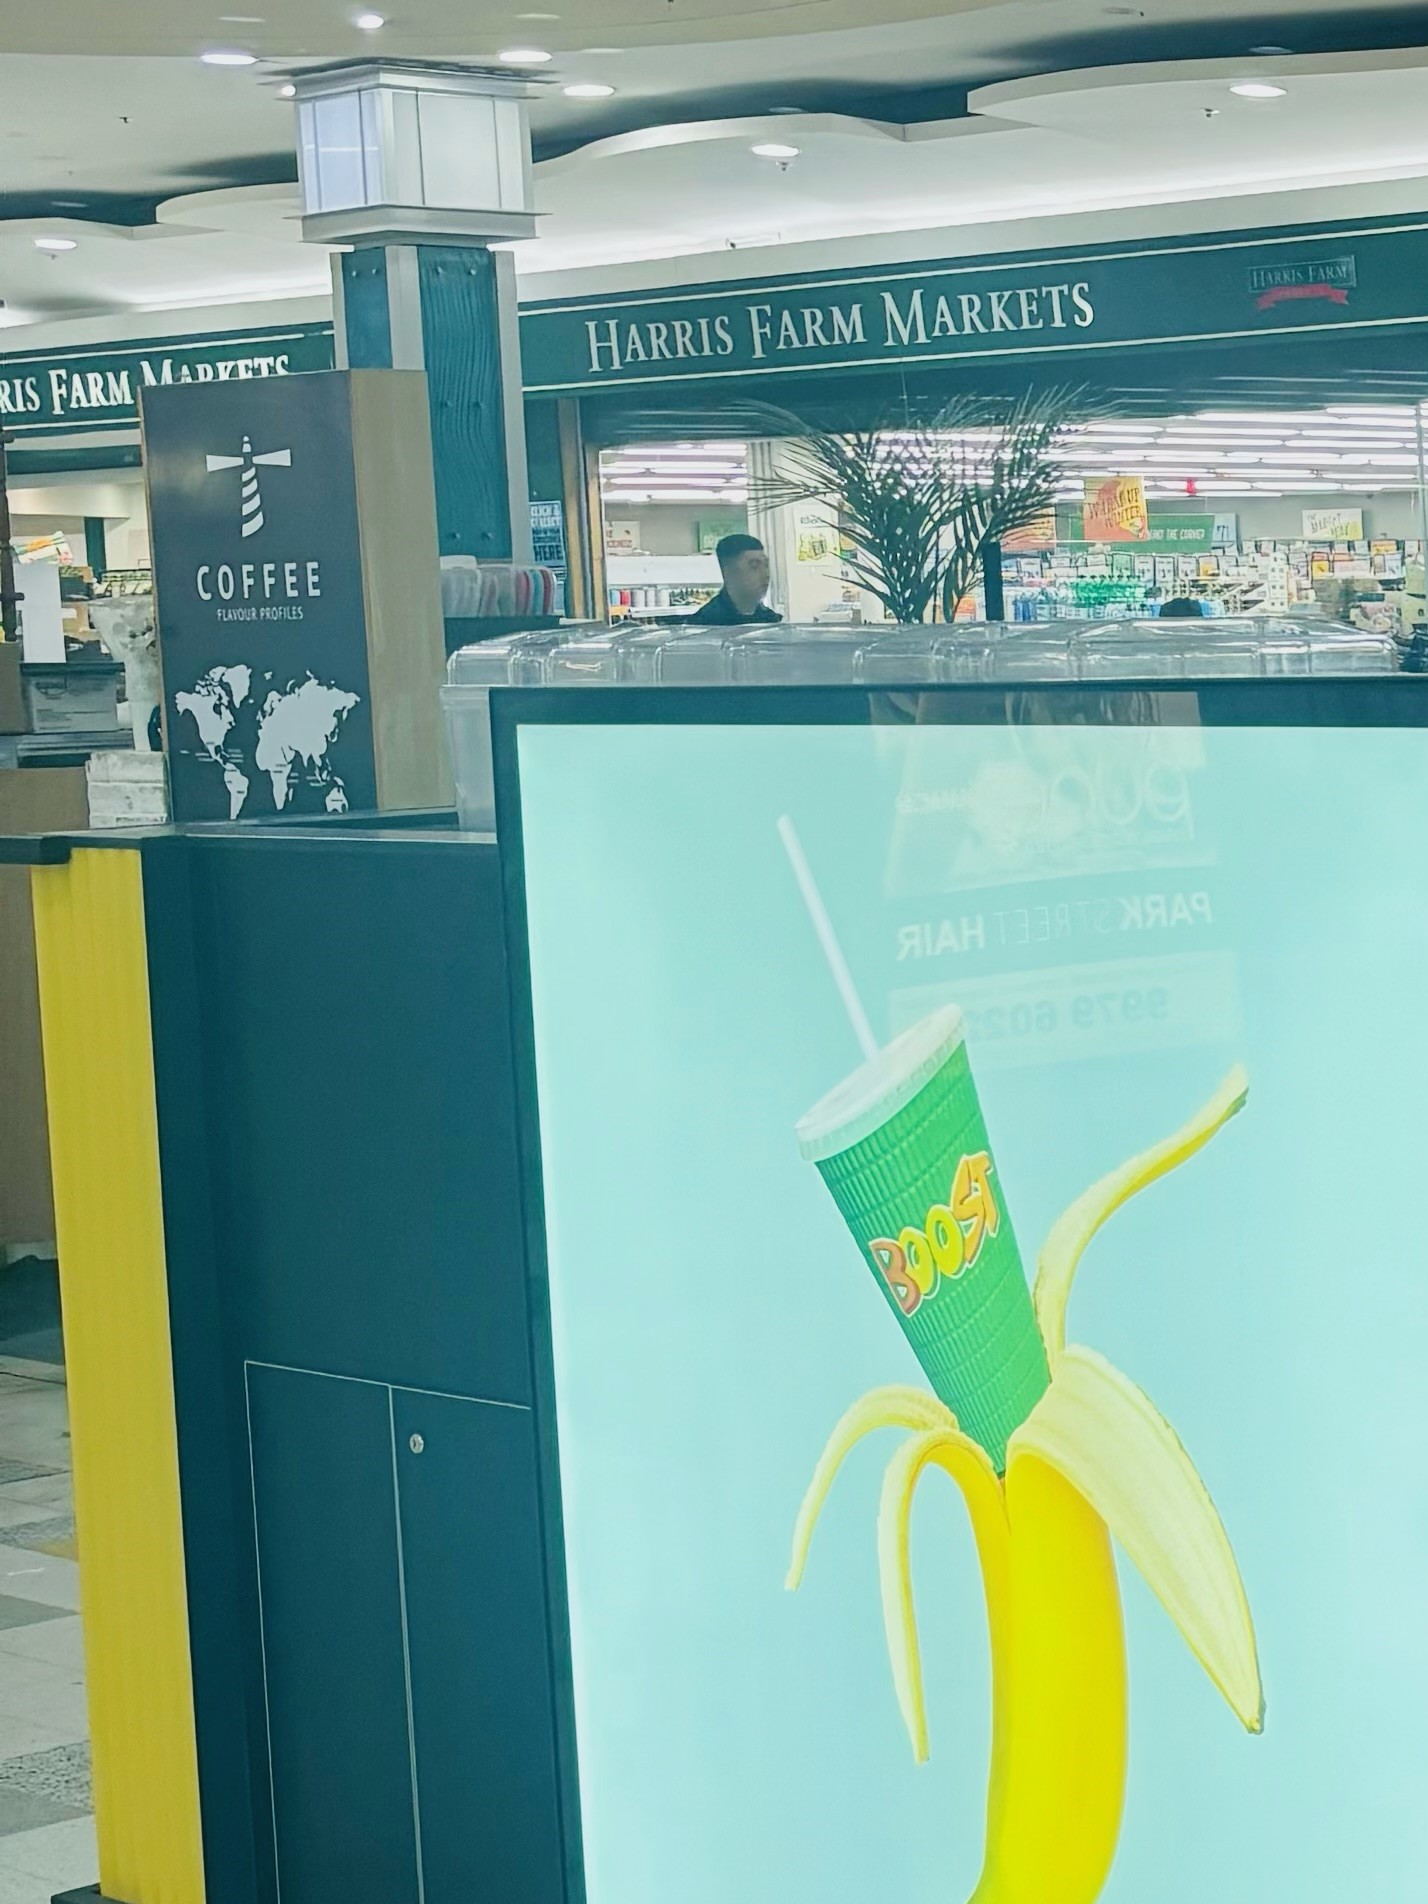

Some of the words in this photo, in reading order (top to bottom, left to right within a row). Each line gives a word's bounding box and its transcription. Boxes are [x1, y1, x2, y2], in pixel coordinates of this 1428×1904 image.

[585, 316, 734, 372] HARRIS
[746, 304, 868, 359] FARM
[880, 282, 1095, 347] MARKETS
[48, 368, 135, 415] FARM
[196, 561, 321, 601] COFFEE
[217, 607, 258, 622] FLAVOUR
[259, 606, 304, 621] PROFILES
[868, 1150, 1000, 1318] BOOST
